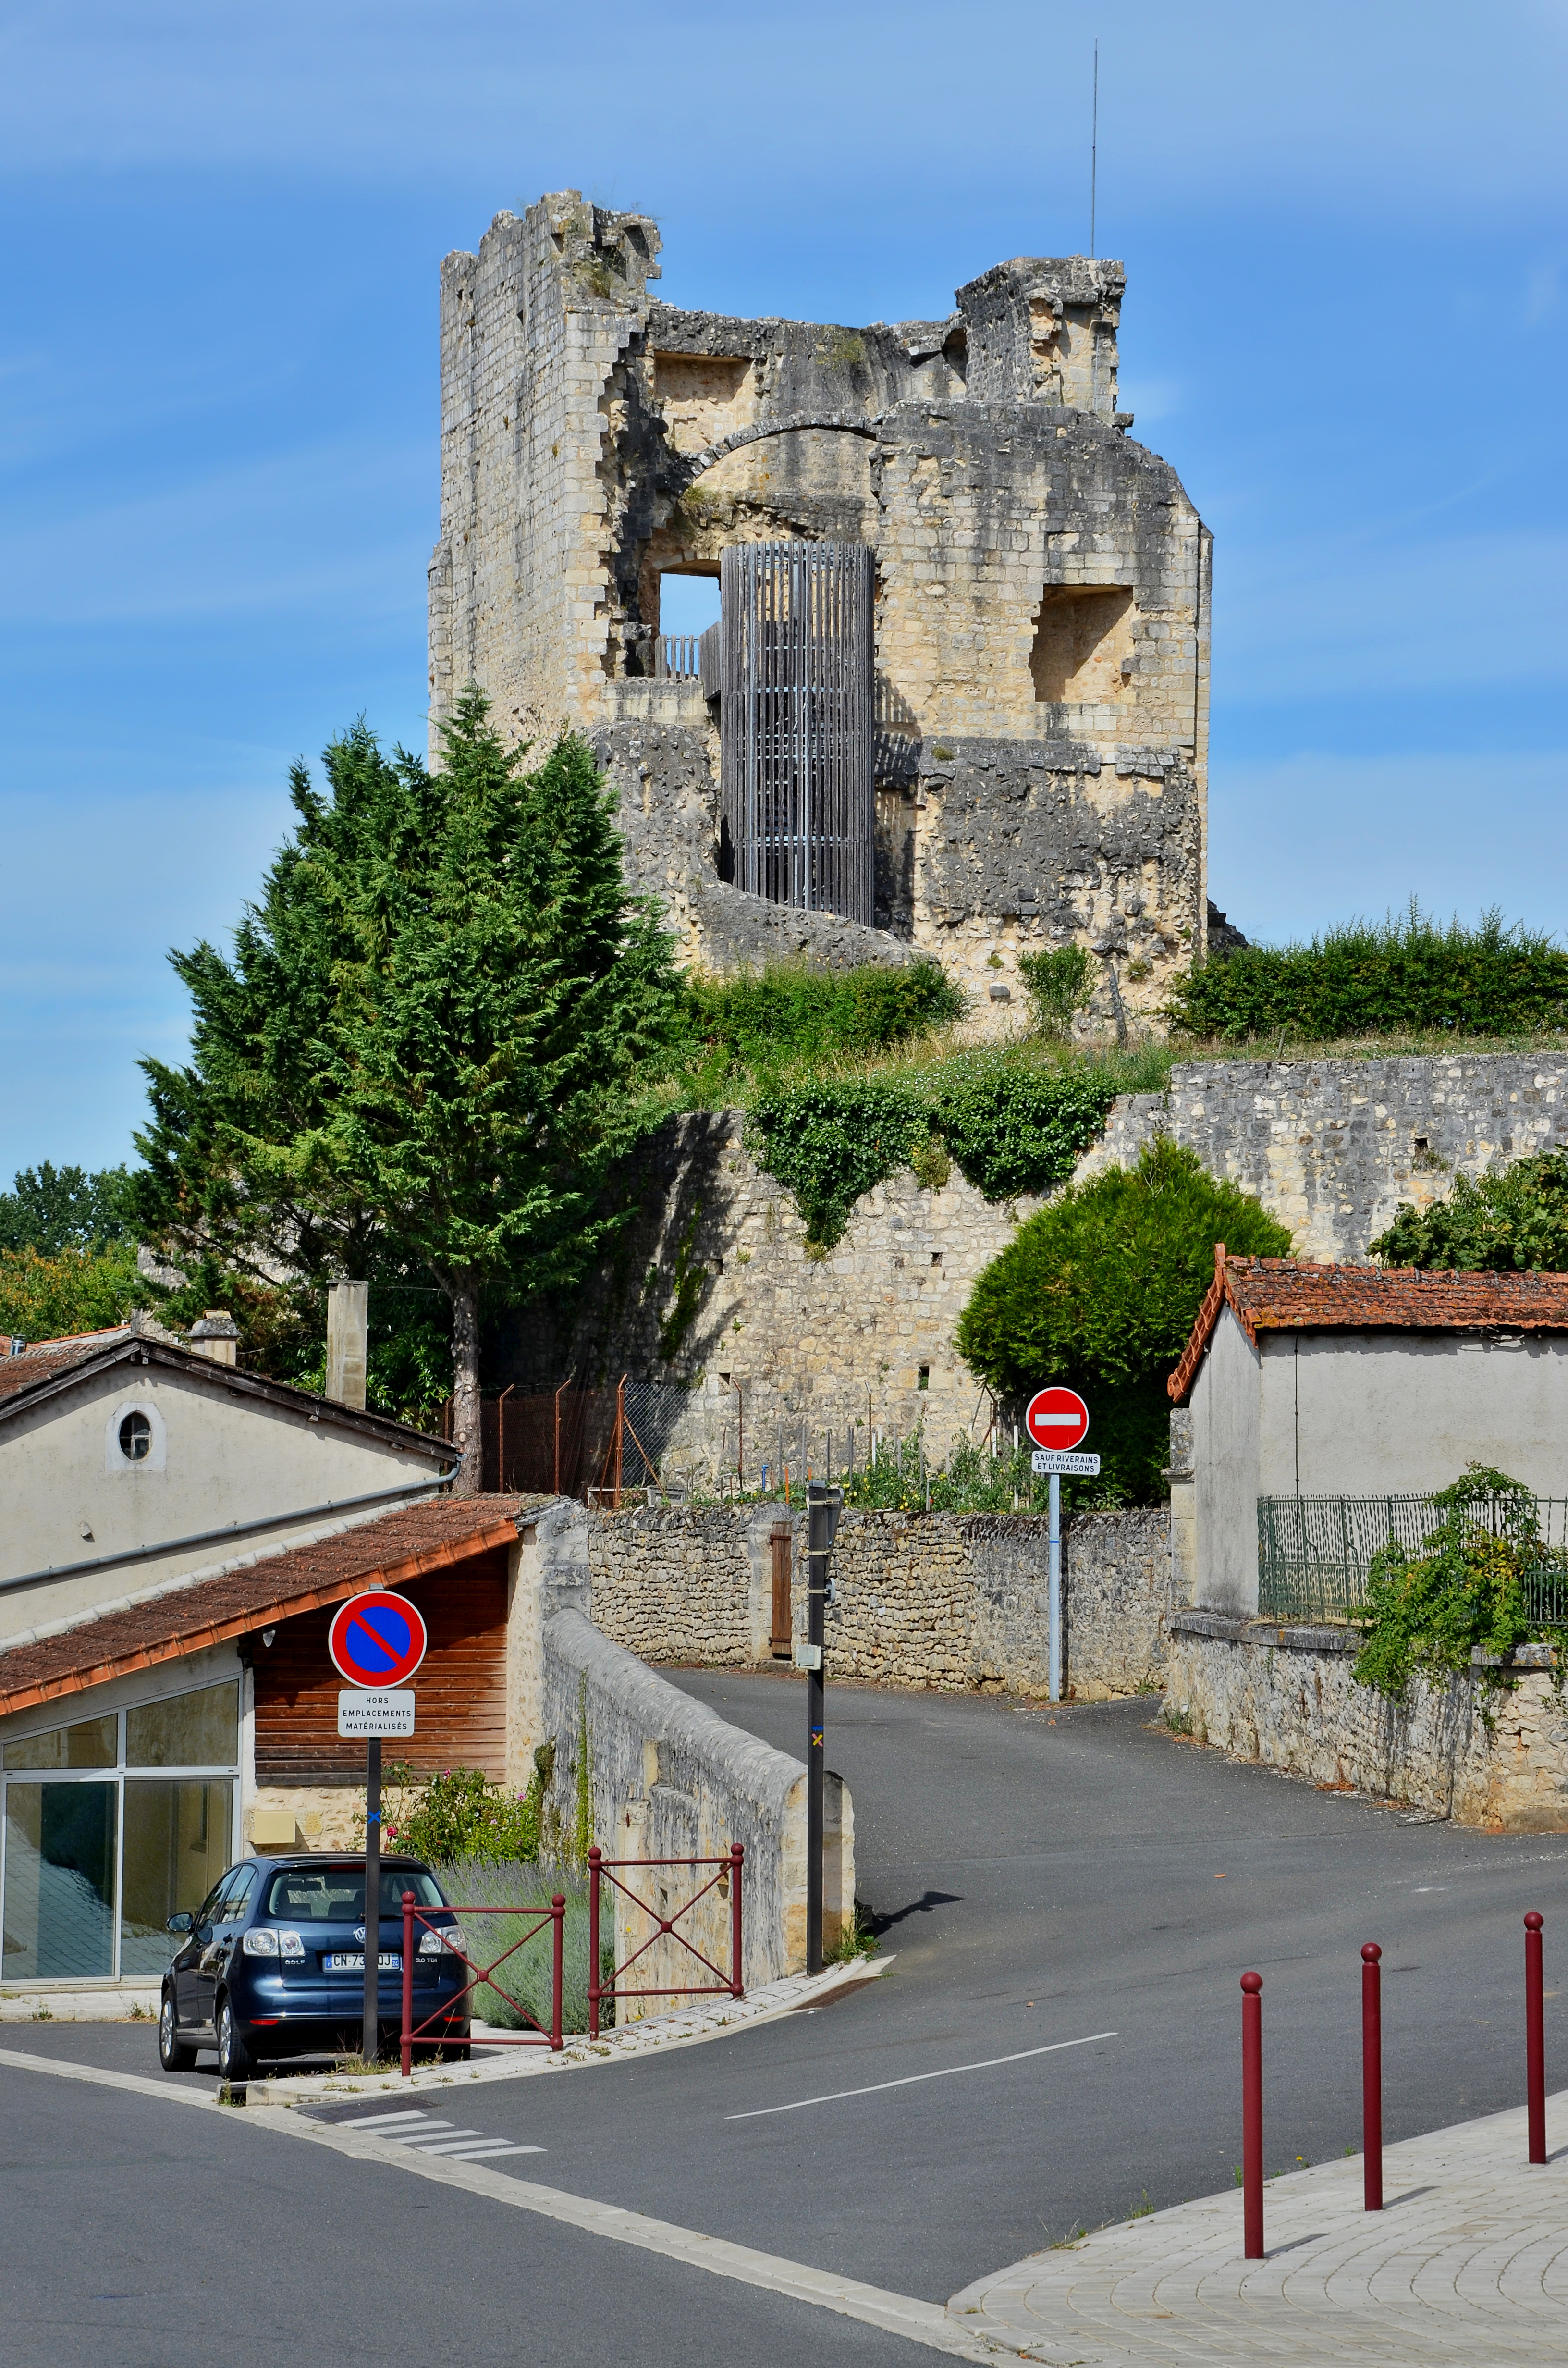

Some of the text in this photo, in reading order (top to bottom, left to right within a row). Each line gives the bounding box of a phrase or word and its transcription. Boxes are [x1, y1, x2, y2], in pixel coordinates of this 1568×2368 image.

[1057, 1455, 1098, 1464] RIVERAINS
[1049, 1463, 1094, 1472] LIVRAISONS
[346, 1721, 407, 1730] MATÉRIALISÉS
